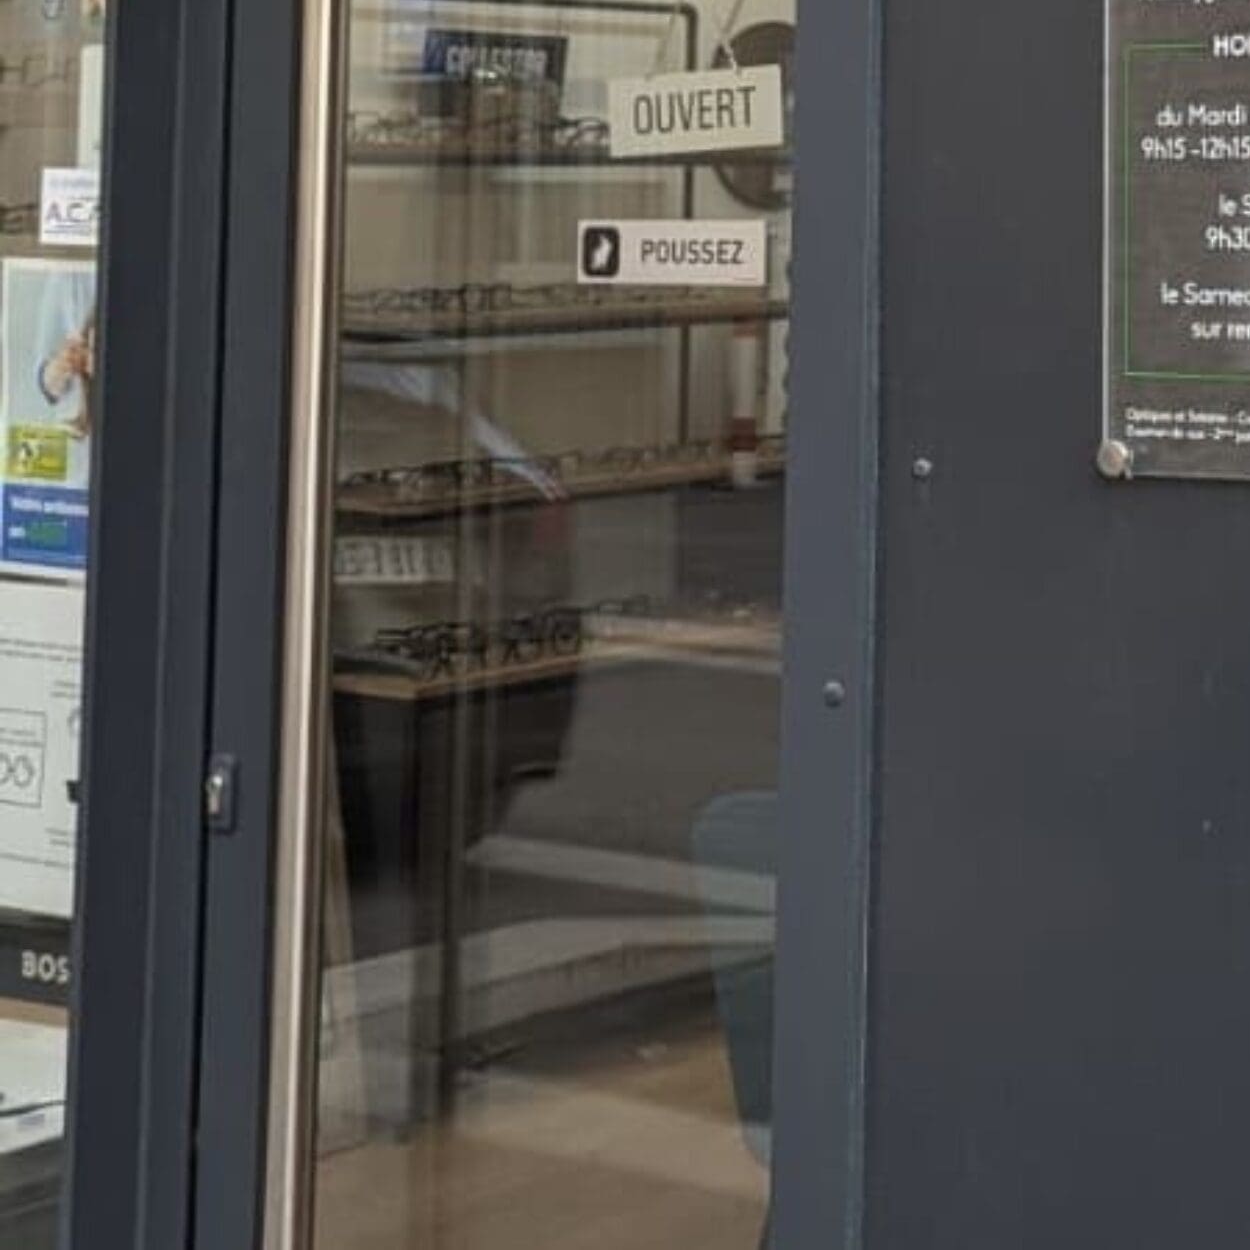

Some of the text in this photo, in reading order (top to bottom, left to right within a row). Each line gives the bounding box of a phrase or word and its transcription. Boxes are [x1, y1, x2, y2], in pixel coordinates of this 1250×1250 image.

[633, 85, 757, 136] OUVERT
[1156, 104, 1183, 127] du
[1187, 104, 1247, 126] Mardi
[1218, 194, 1237, 217] le
[640, 238, 745, 265] POUSSEZ
[1160, 282, 1179, 304] le
[1190, 322, 1223, 341] sur
